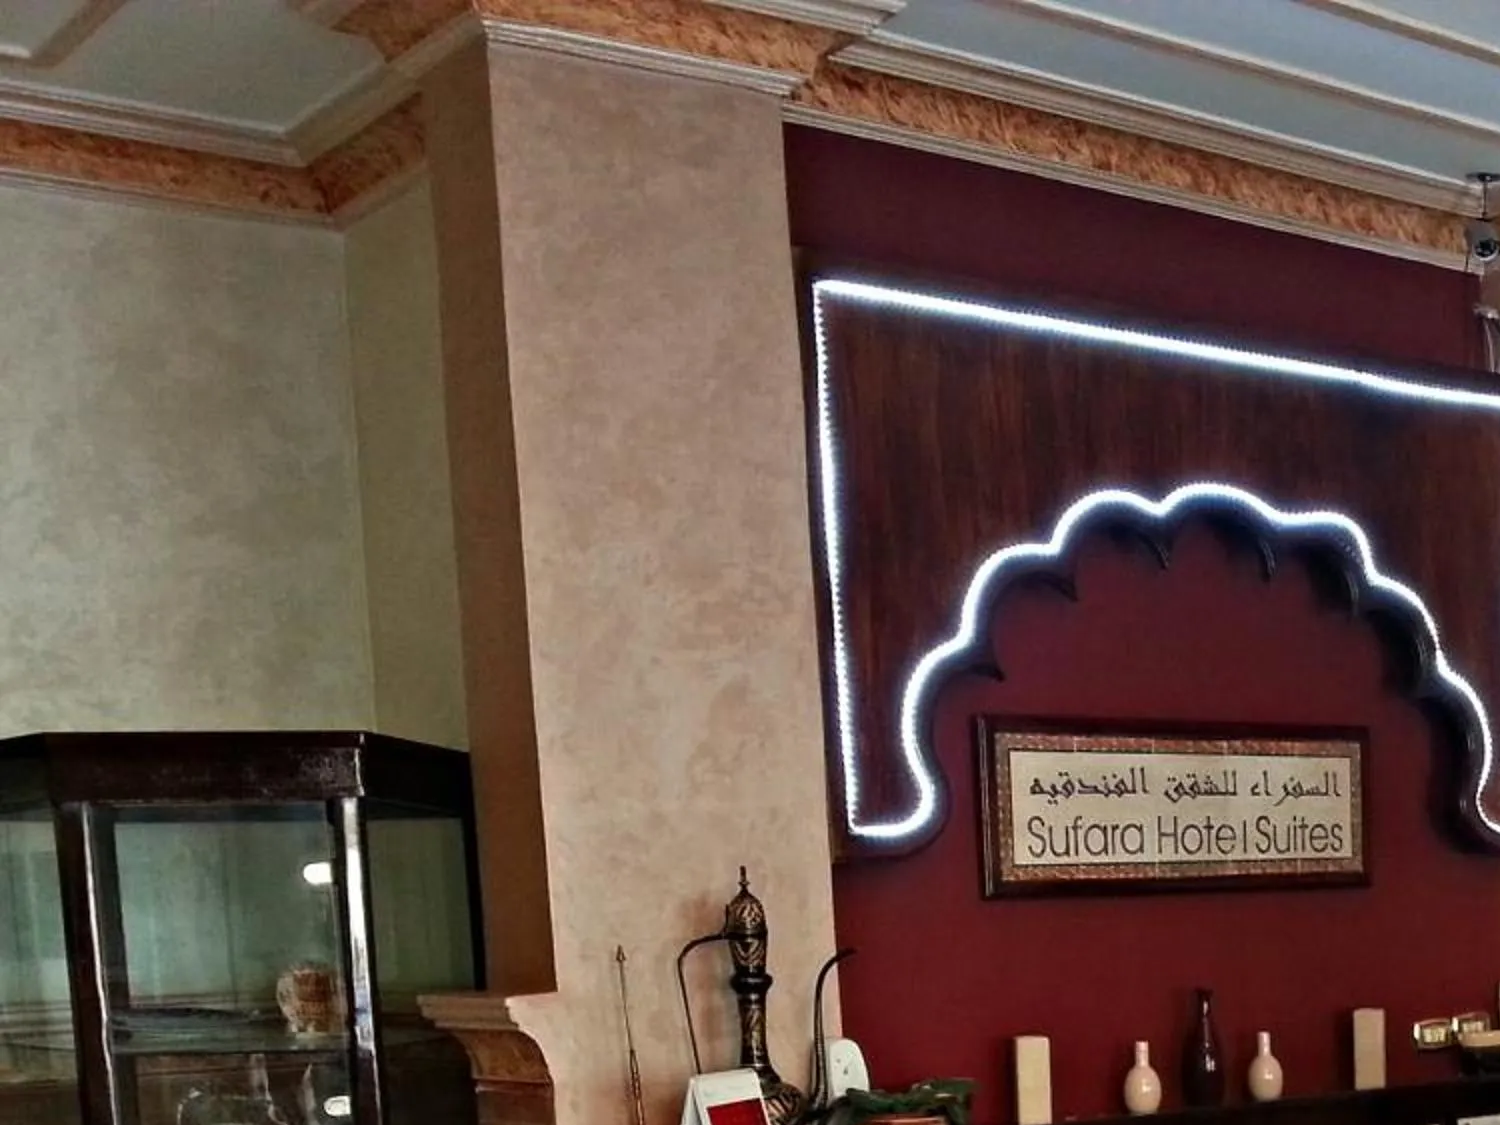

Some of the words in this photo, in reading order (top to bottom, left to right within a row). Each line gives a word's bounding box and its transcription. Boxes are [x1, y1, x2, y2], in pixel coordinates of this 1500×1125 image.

[1163, 769, 1238, 804] للشقق
[1250, 769, 1342, 806] السفراء
[1027, 815, 1145, 858] Sufara
[1157, 815, 1248, 856] Hotel
[1254, 814, 1344, 855] Suites
